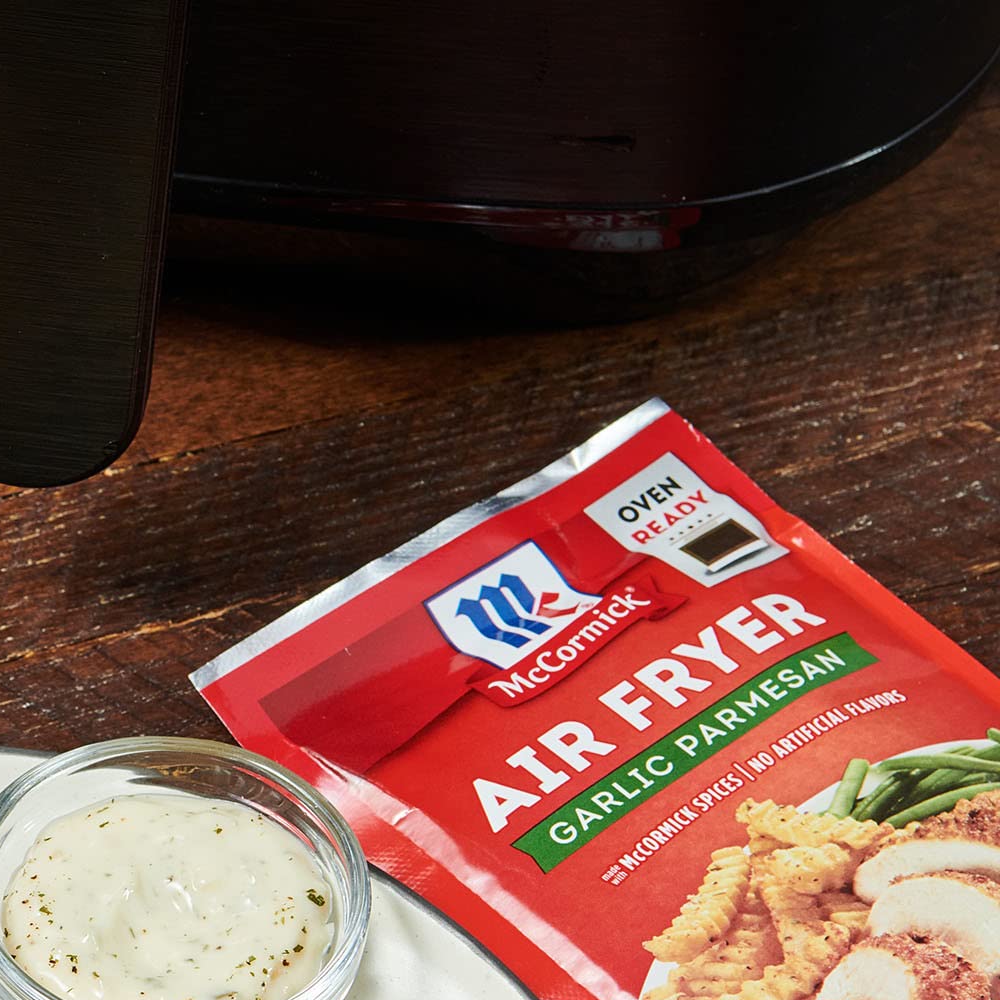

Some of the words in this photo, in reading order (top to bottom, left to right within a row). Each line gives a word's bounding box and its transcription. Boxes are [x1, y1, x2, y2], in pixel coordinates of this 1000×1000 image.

[618, 476, 682, 522] OVEN
[632, 489, 708, 544] READY
[488, 593, 651, 698] McCormick
[472, 721, 617, 833] AIR
[598, 593, 826, 732] FRYER
[549, 755, 674, 845] GARLIC
[674, 649, 846, 757] PARMESAN
[618, 805, 699, 871] McCORMICK
[692, 773, 743, 812] SPICES
[747, 751, 775, 773] NO
[770, 708, 850, 758] ARTIFICIAL
[843, 689, 907, 717] FLAVORS
[601, 864, 621, 881] made
[611, 870, 628, 886] with
